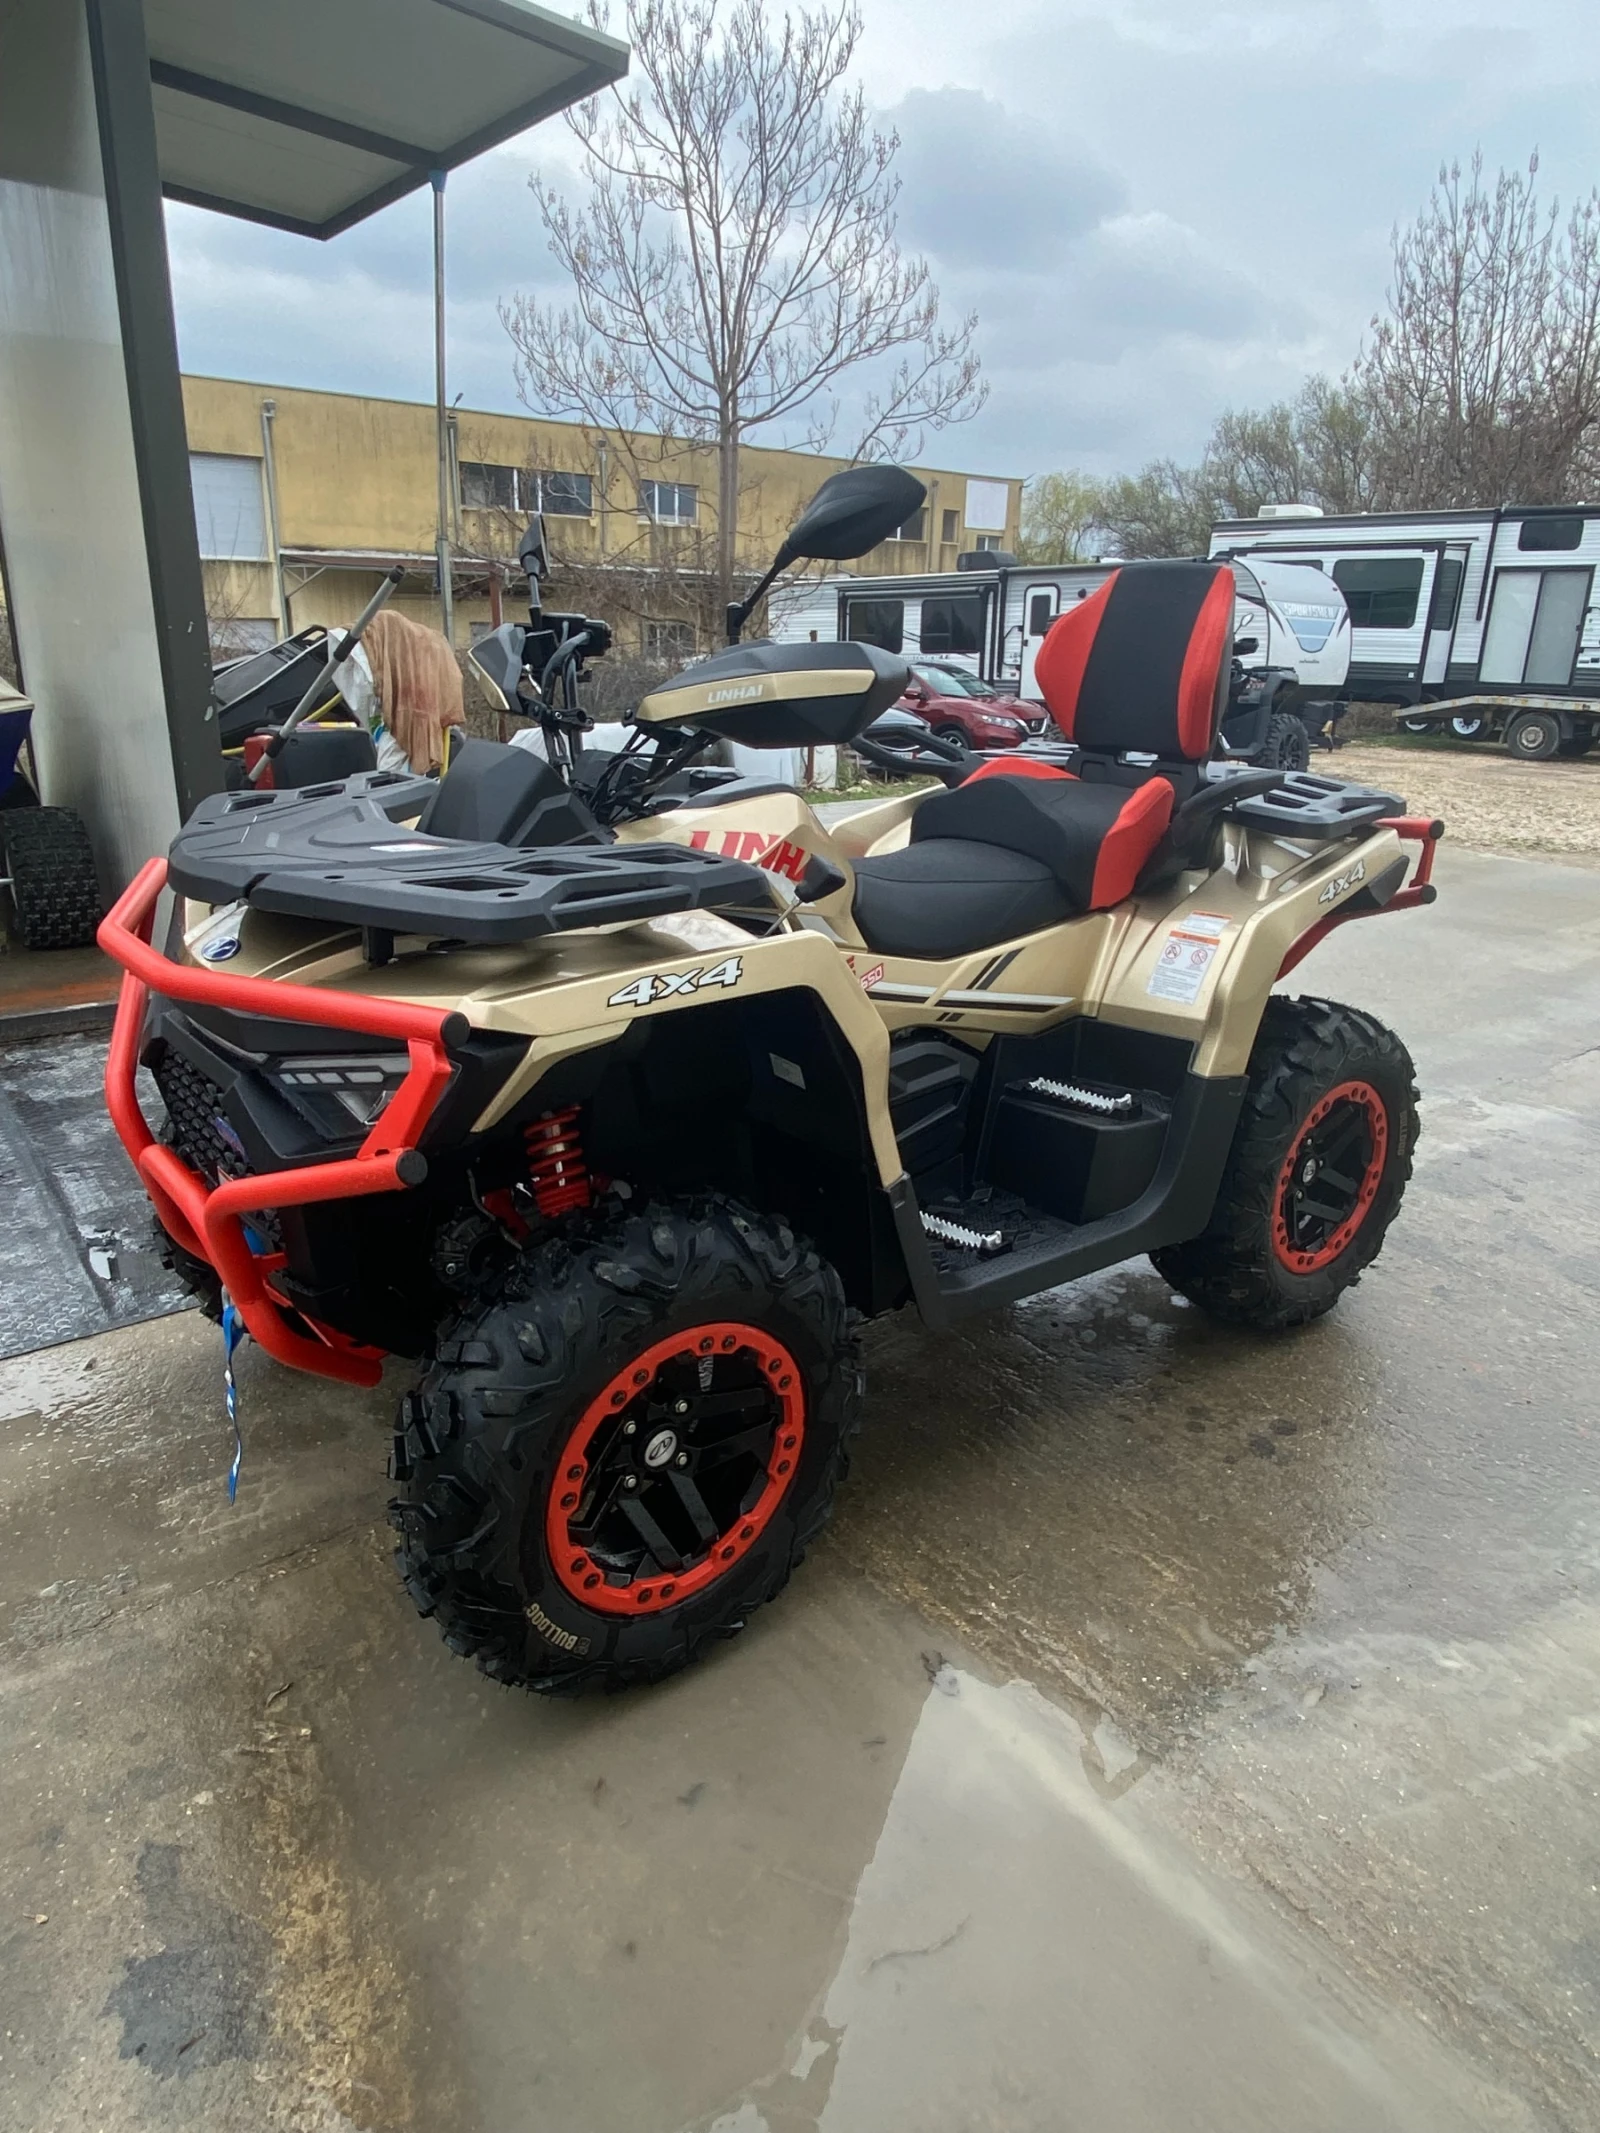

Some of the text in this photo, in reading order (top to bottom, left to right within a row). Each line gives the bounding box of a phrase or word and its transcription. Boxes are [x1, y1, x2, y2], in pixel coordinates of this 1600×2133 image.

[708, 684, 764, 703] LINHAI
[690, 830, 806, 882] LINH
[526, 1603, 579, 1650] BULLDOG
